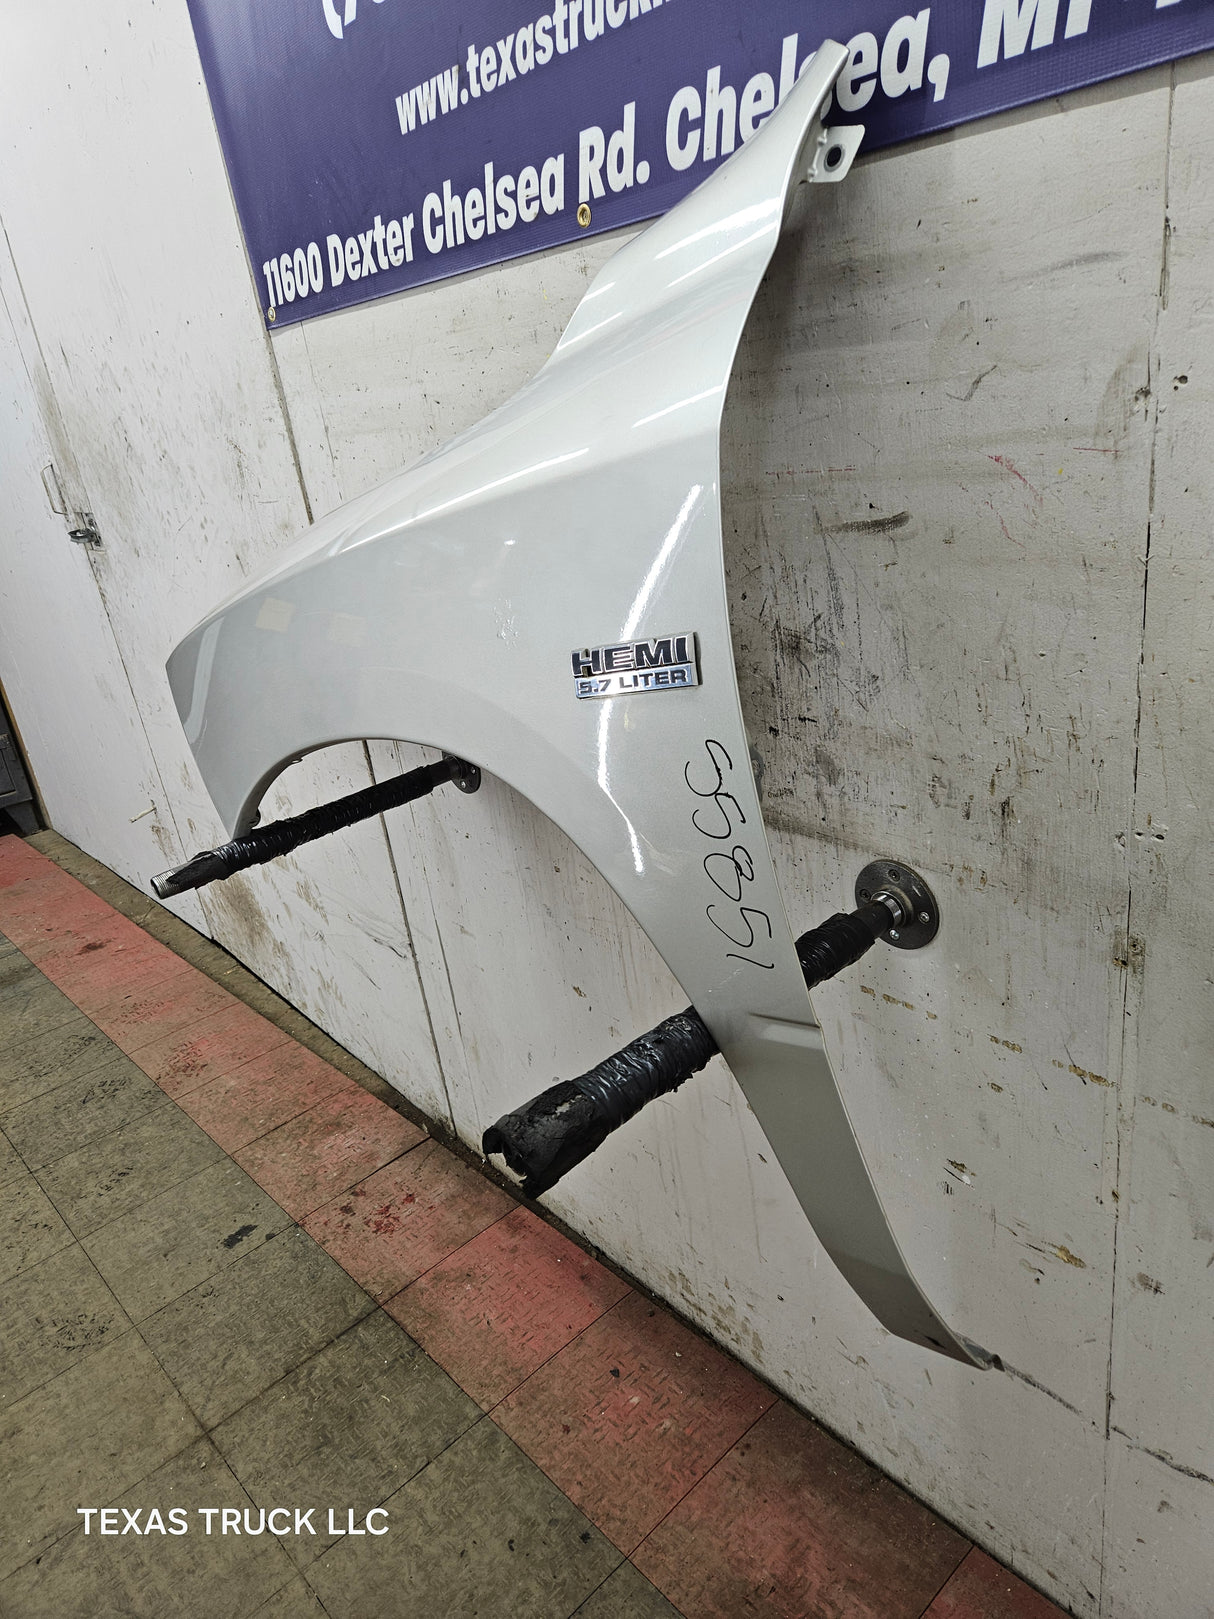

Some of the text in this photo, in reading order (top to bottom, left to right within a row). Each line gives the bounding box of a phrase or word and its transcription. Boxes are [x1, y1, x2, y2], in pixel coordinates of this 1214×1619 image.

[263, 242, 324, 307] 11600
[327, 212, 415, 287] Dexter
[422, 153, 564, 254] Chelsea
[579, 101, 651, 203] Rd.
[666, 8, 950, 171] Chelea,
[571, 635, 689, 676] HEMI
[578, 668, 688, 695] 5.7 LITER
[685, 739, 775, 969] 55851
